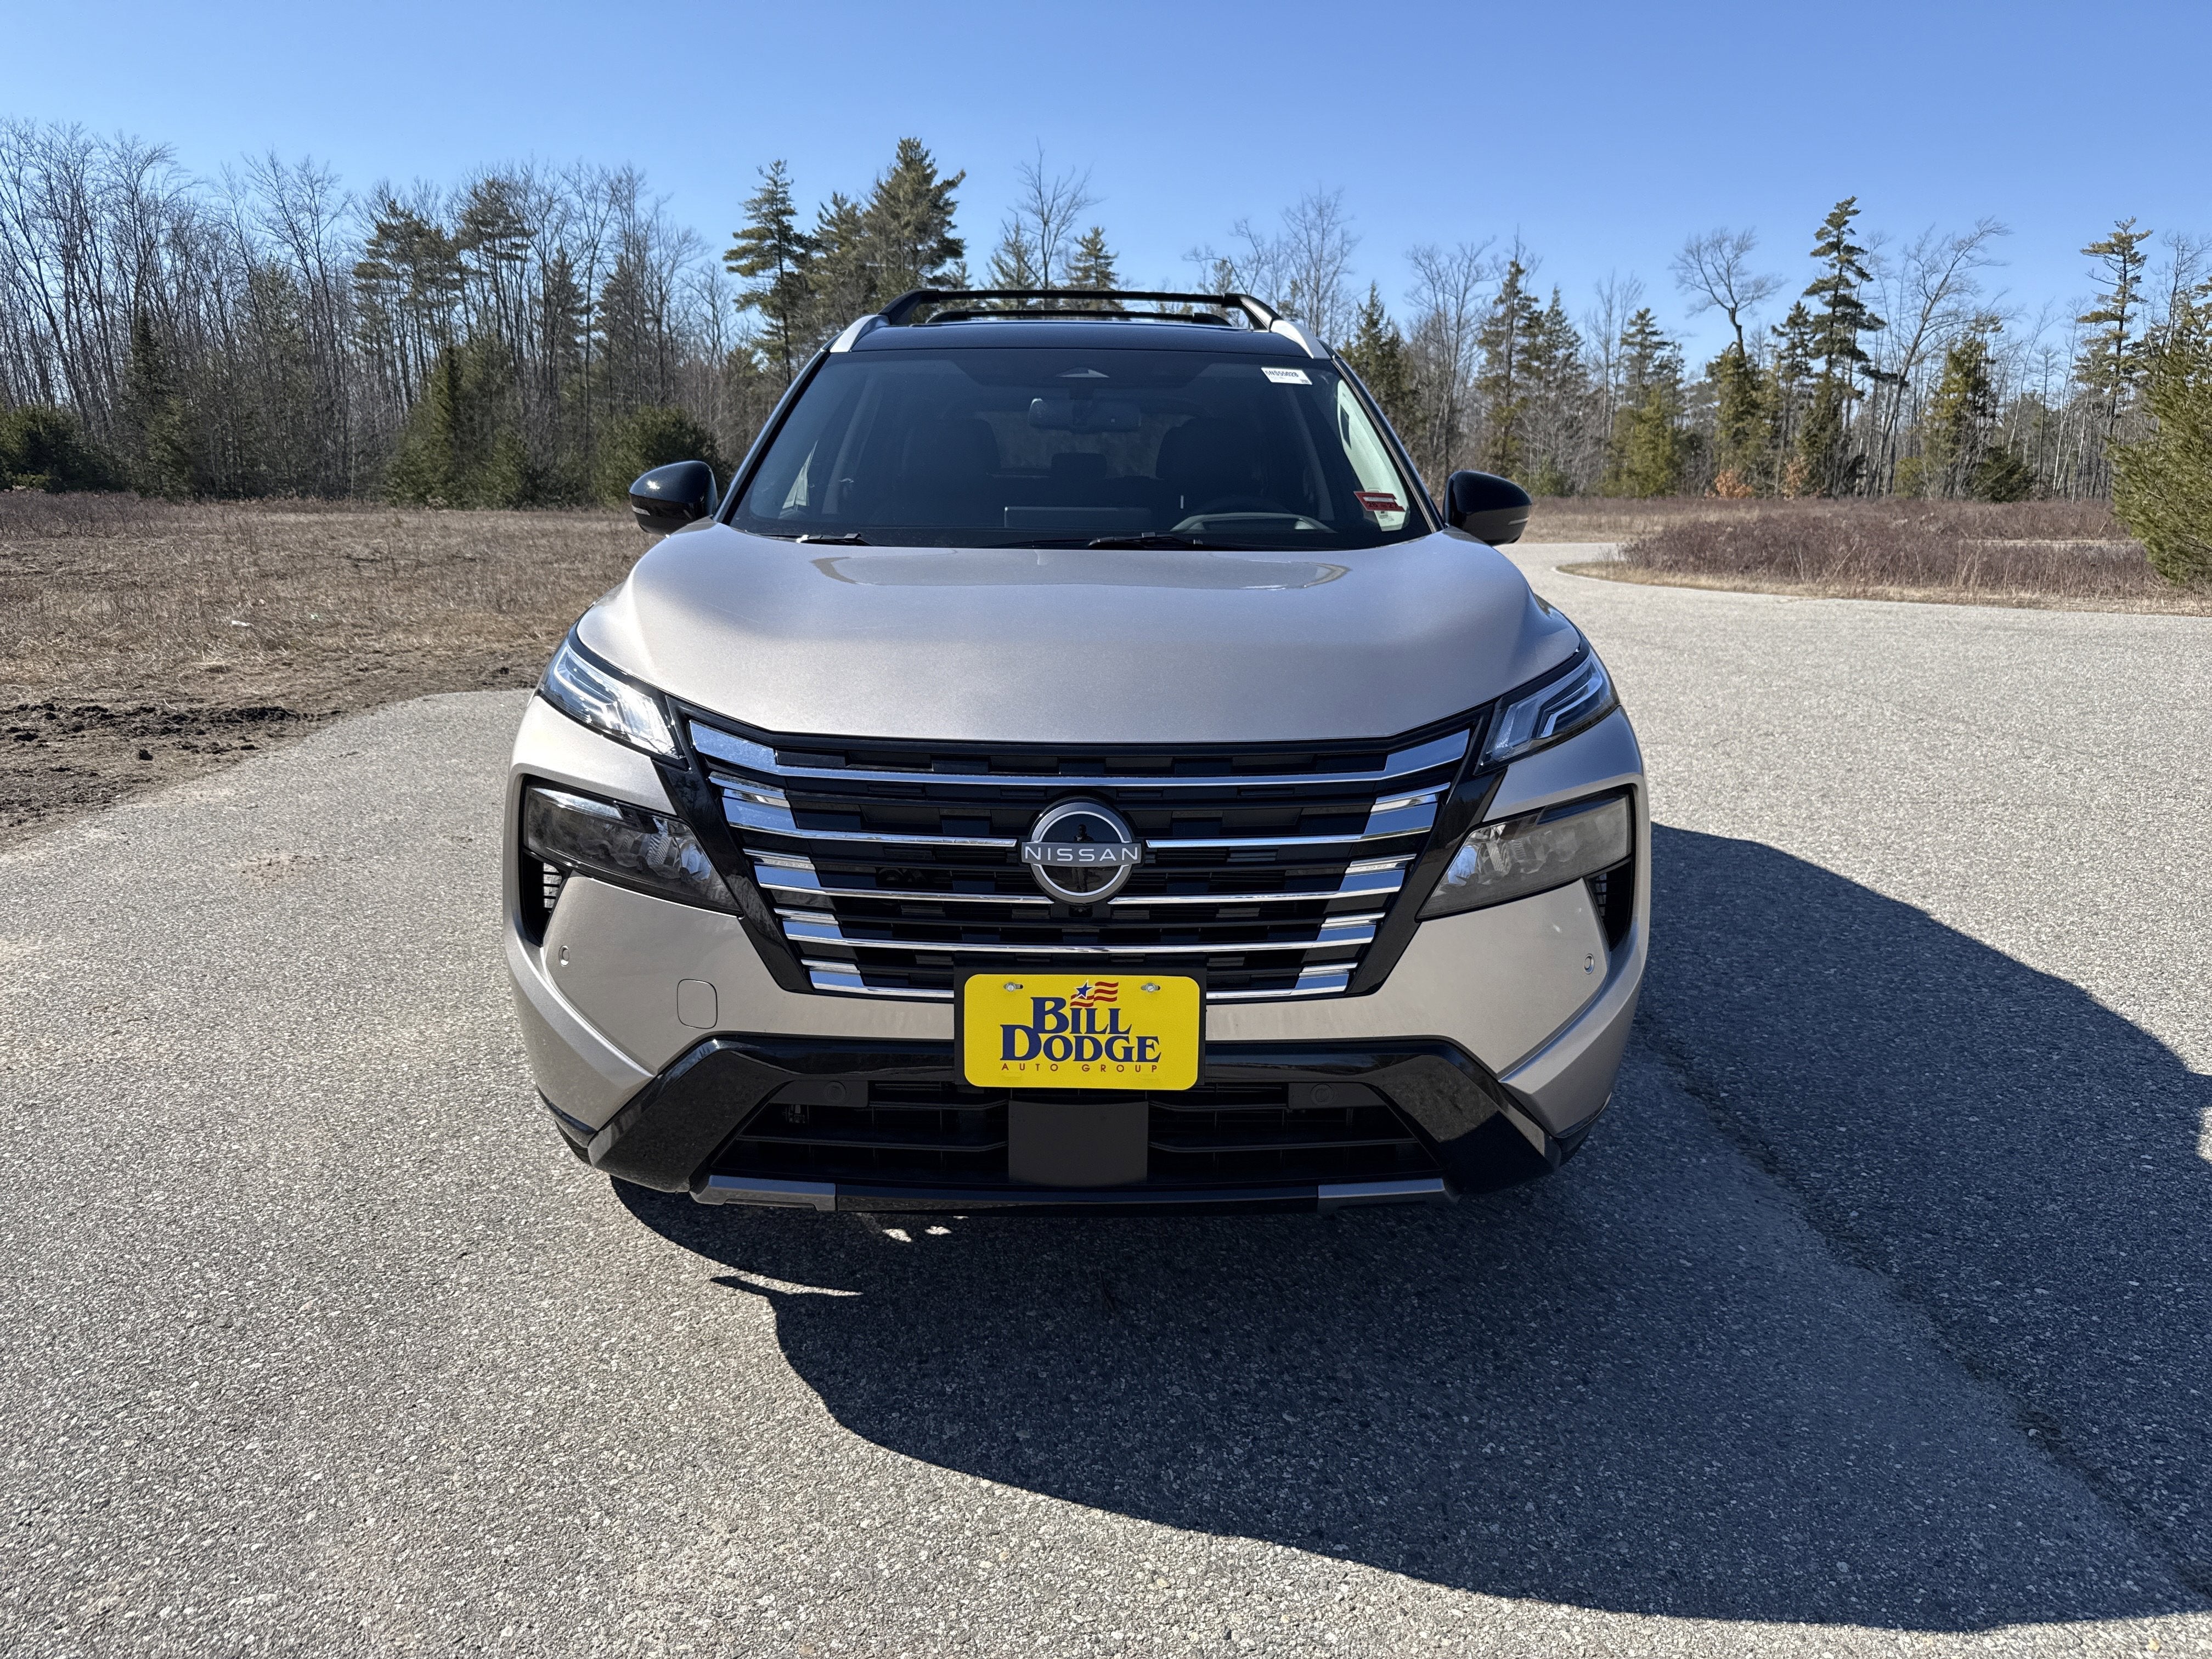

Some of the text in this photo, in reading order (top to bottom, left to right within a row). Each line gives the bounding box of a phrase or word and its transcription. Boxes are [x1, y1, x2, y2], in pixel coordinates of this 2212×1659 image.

[1025, 846, 1138, 862] NISSAN
[1030, 997, 1132, 1035] BILL
[1000, 1024, 1162, 1063] DODGE
[1001, 1063, 1158, 1073] AUTO GROUP
